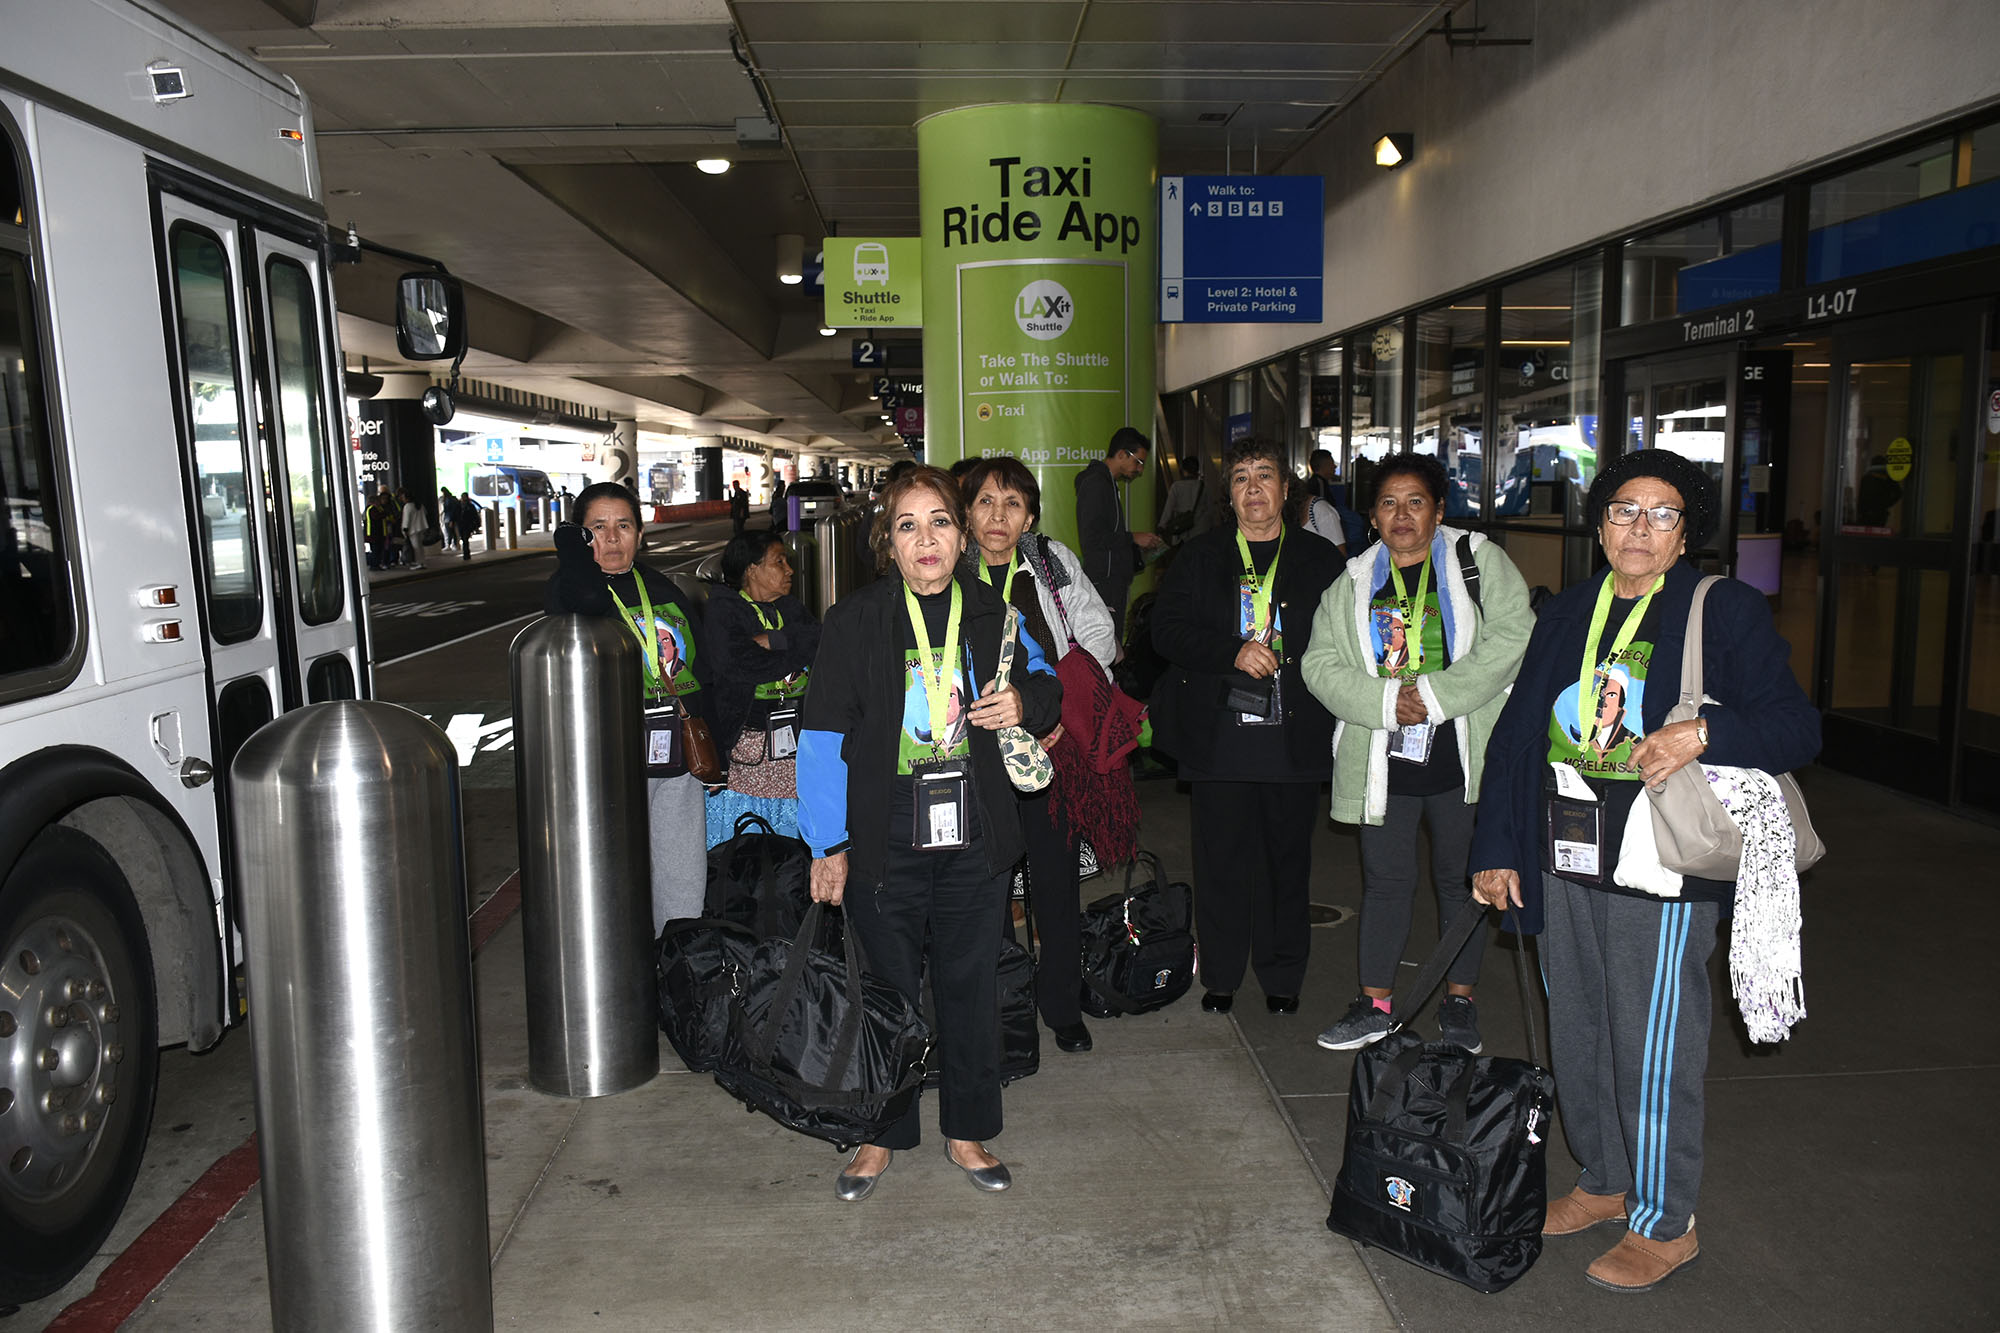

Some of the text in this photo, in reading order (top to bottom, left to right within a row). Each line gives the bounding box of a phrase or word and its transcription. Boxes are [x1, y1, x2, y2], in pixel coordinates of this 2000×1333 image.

[989, 156, 1091, 198] Taxi
[1207, 185, 1255, 196] Walk to:
[943, 200, 1140, 254] Ride App
[842, 291, 901, 304] Shuttle
[1207, 287, 1298, 298] Level 2: Hotel &
[1207, 301, 1296, 314] Private Parking
[1807, 288, 1857, 320] L1-07
[879, 314, 895, 322] App
[1026, 323, 1063, 332] Shuttle
[1683, 309, 1755, 342] Terminal 2
[859, 341, 874, 363] 2
[979, 353, 1110, 369] Take The Shuttle
[879, 377, 890, 393] 2
[979, 371, 1069, 387] or Walk To:
[996, 404, 1025, 417] Taxi
[602, 432, 625, 446] 2K
[1020, 447, 1050, 463] App
[1056, 447, 1107, 461] Pickup
[371, 461, 390, 471] 600
[1399, 595, 1412, 630] F.C.M.
[1620, 650, 1633, 660] DE
[928, 788, 953, 796] MEXICO
[1562, 809, 1588, 819] MEXICO
